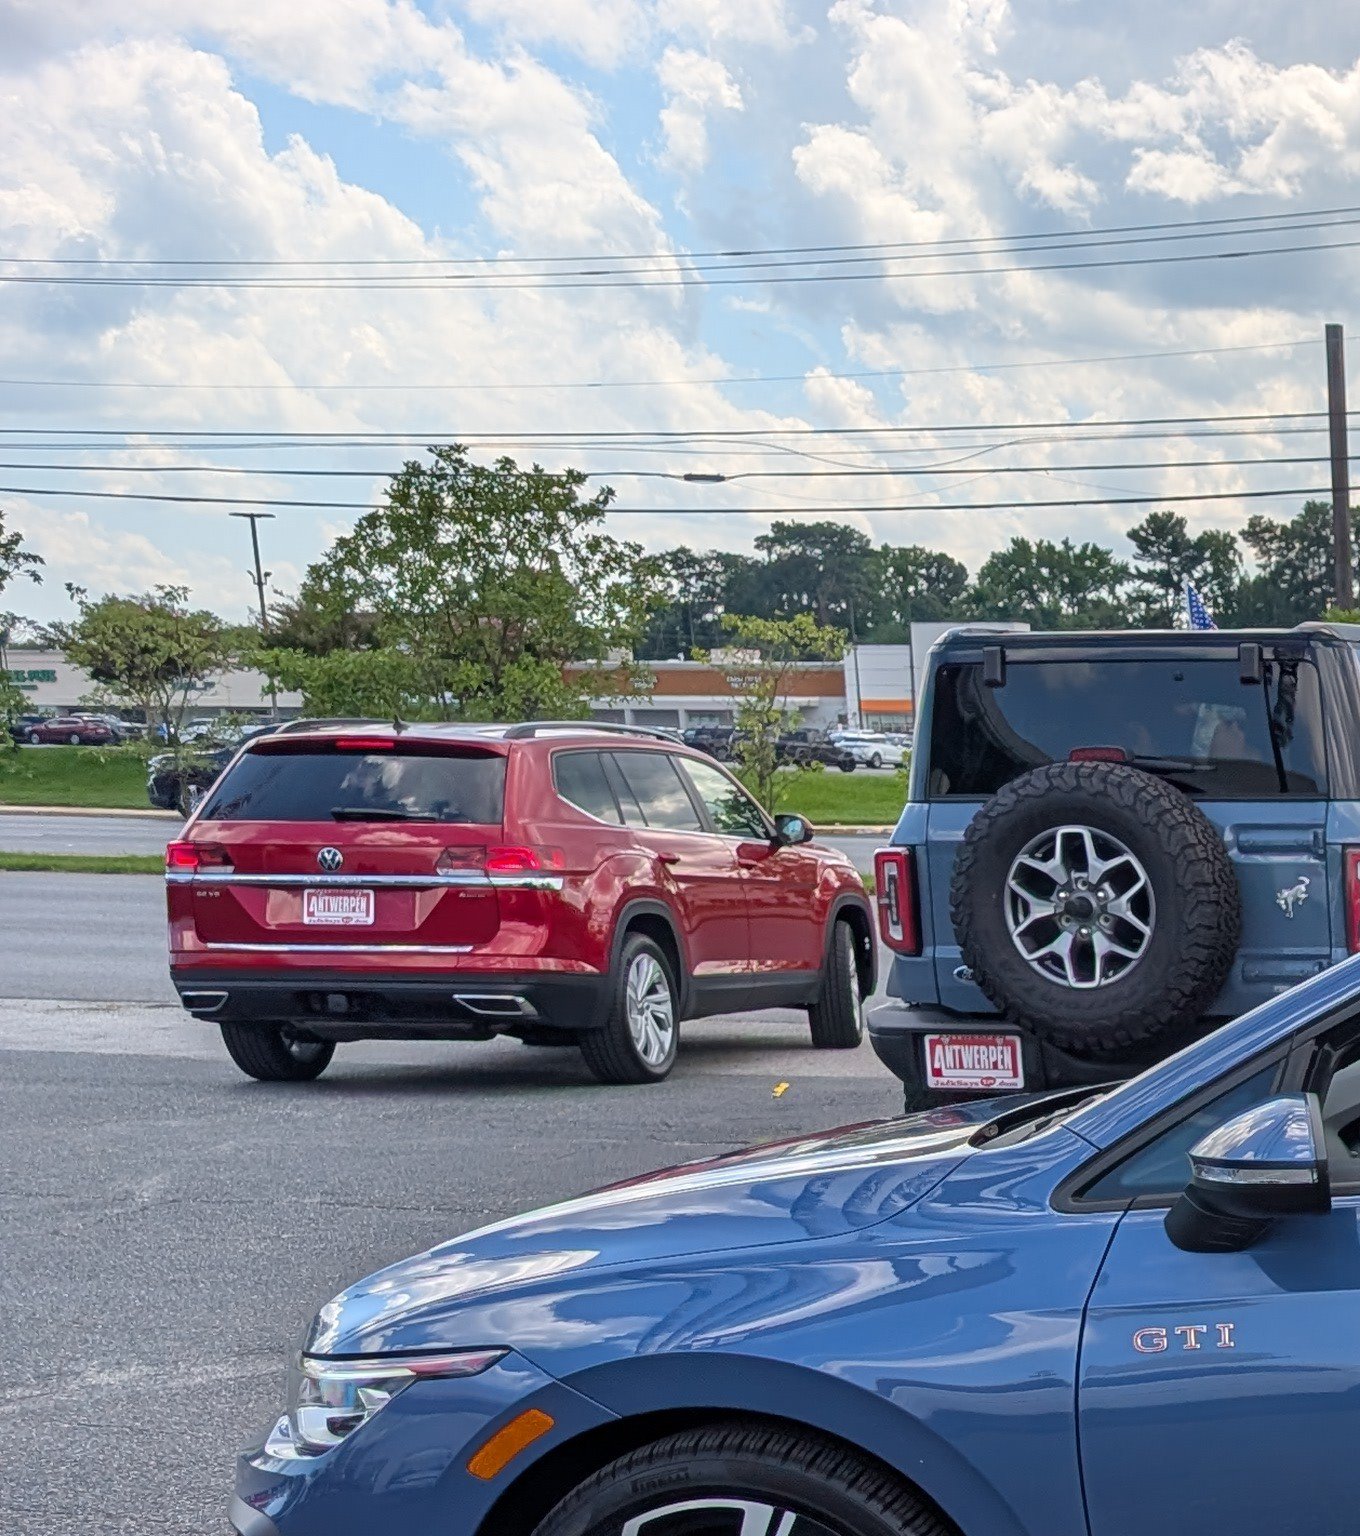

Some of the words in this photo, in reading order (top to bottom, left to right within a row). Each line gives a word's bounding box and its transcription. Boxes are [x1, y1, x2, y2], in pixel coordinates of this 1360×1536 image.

[309, 896, 367, 912] ANTWERPEN
[934, 1045, 1012, 1070] ANTWERPEN
[1133, 1323, 1234, 1353] GTI
